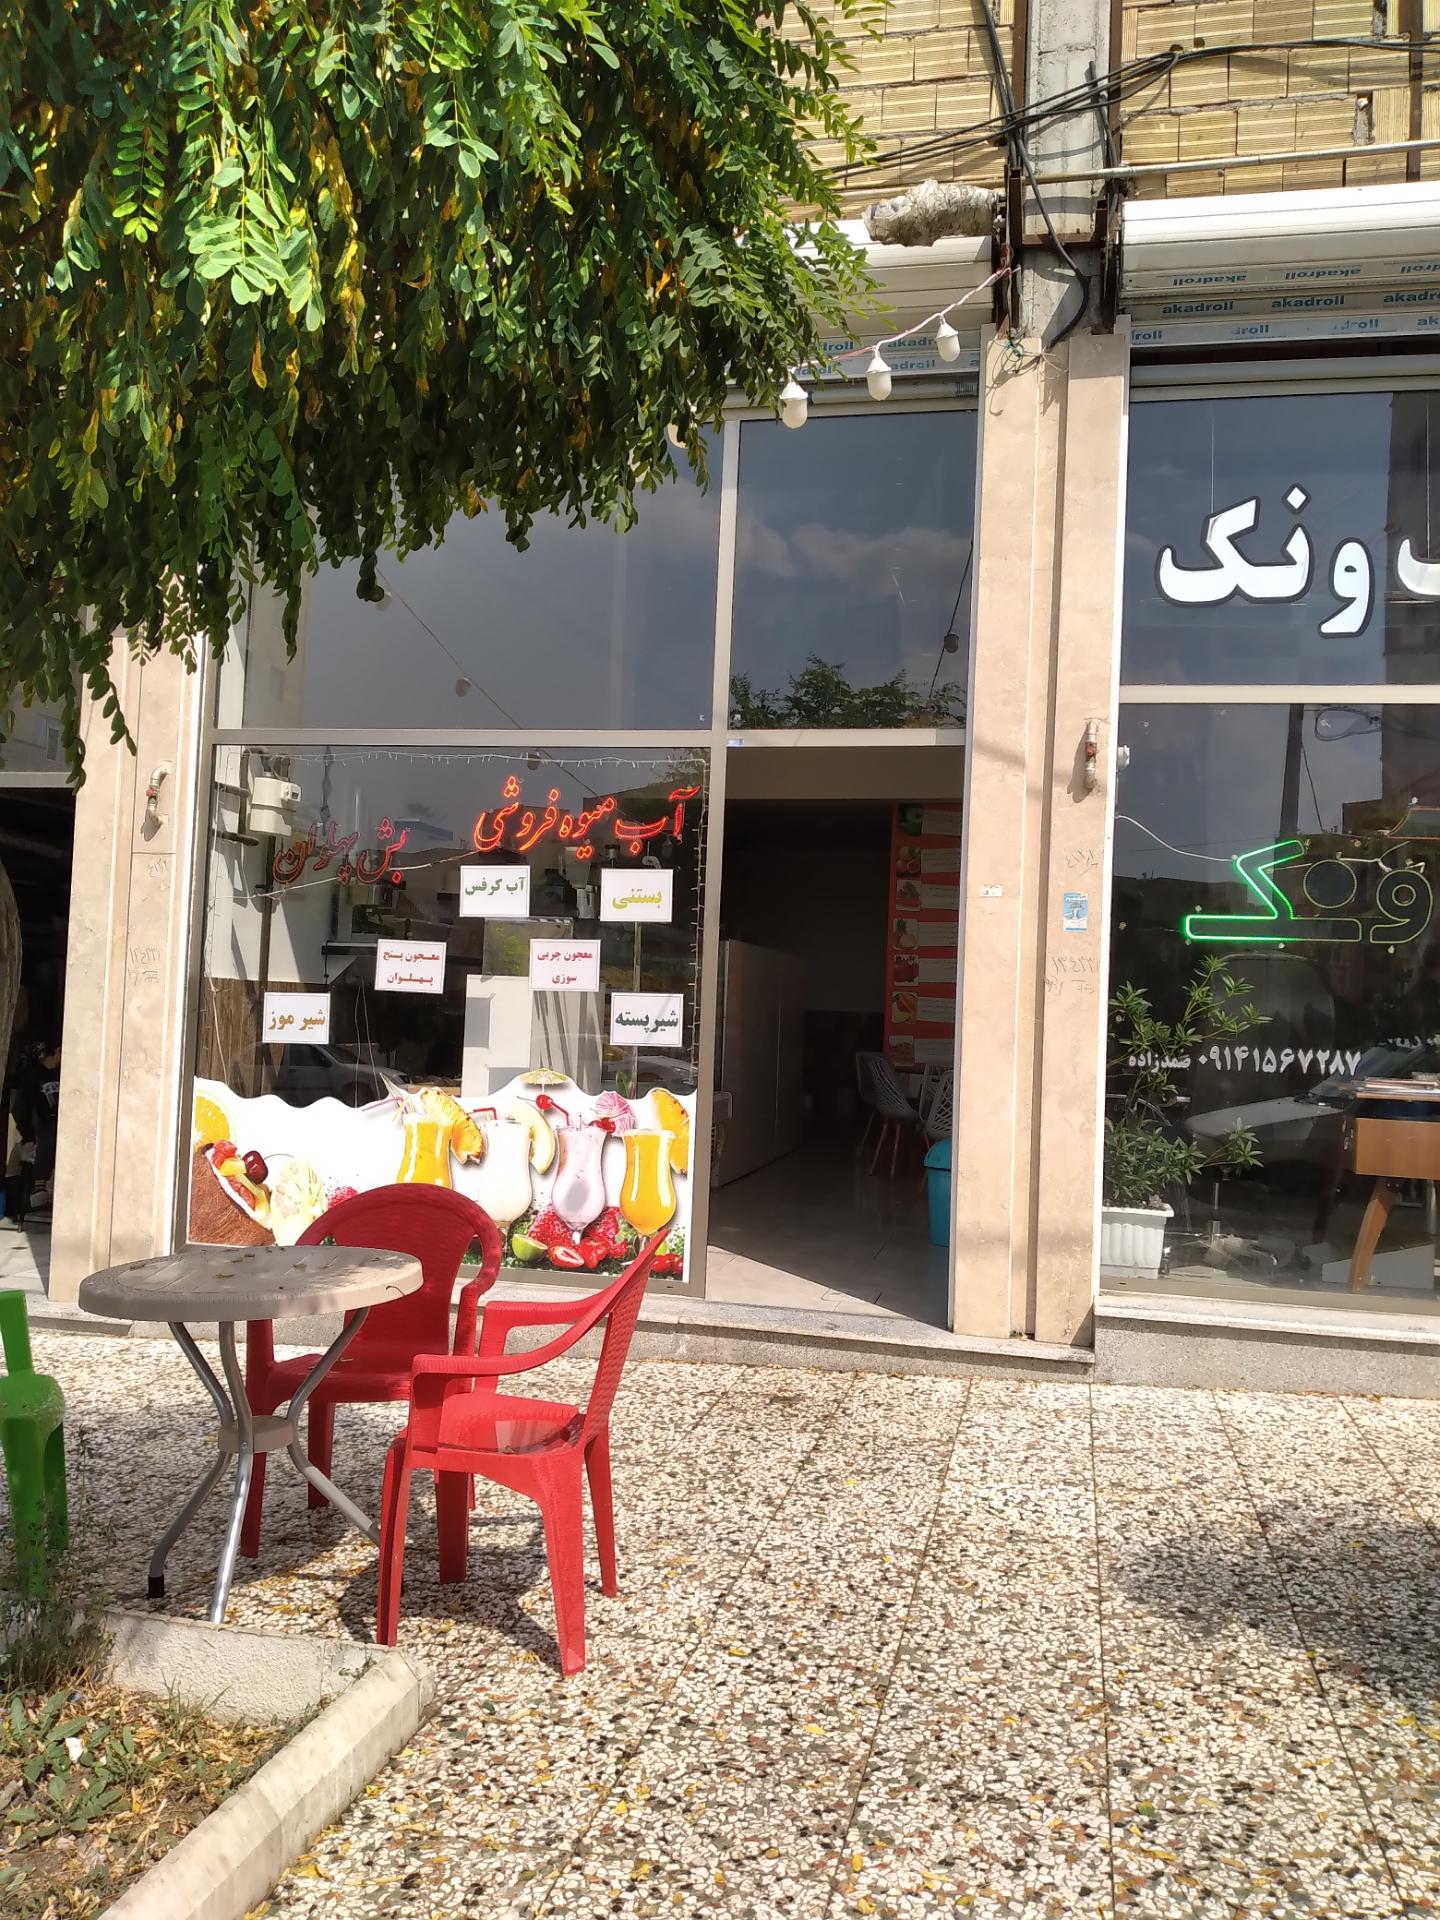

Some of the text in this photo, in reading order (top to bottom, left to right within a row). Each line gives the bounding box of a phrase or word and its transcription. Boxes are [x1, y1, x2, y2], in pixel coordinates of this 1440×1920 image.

[1162, 290, 1440, 314] akadroll akadroll akadr
[890, 360, 935, 370] adroll
[1155, 482, 1375, 639] ونک
[473, 775, 701, 860] آب میوه فروشی
[464, 876, 527, 896] آب کرفس
[612, 888, 662, 910] بستنی
[404, 952, 440, 963] معجون
[537, 951, 593, 962] معجون چربی
[387, 971, 434, 987] پهلوان
[551, 972, 577, 985] سوزی
[267, 1008, 326, 1031] شیر موز
